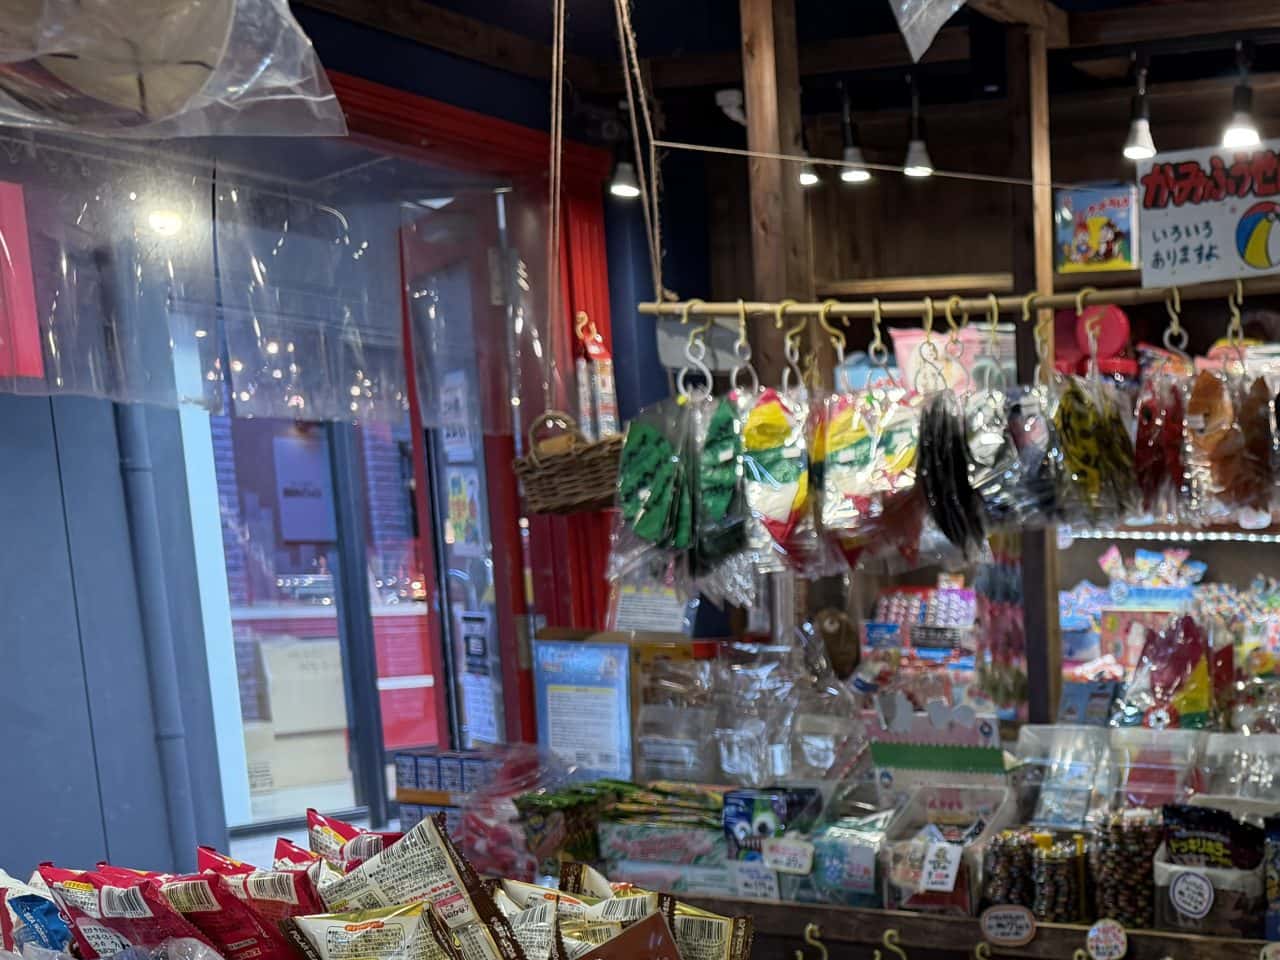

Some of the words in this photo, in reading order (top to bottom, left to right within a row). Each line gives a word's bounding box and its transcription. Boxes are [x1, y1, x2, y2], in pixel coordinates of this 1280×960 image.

[1152, 221, 1214, 243] いろいろ
[1151, 244, 1221, 269] ありますよ
